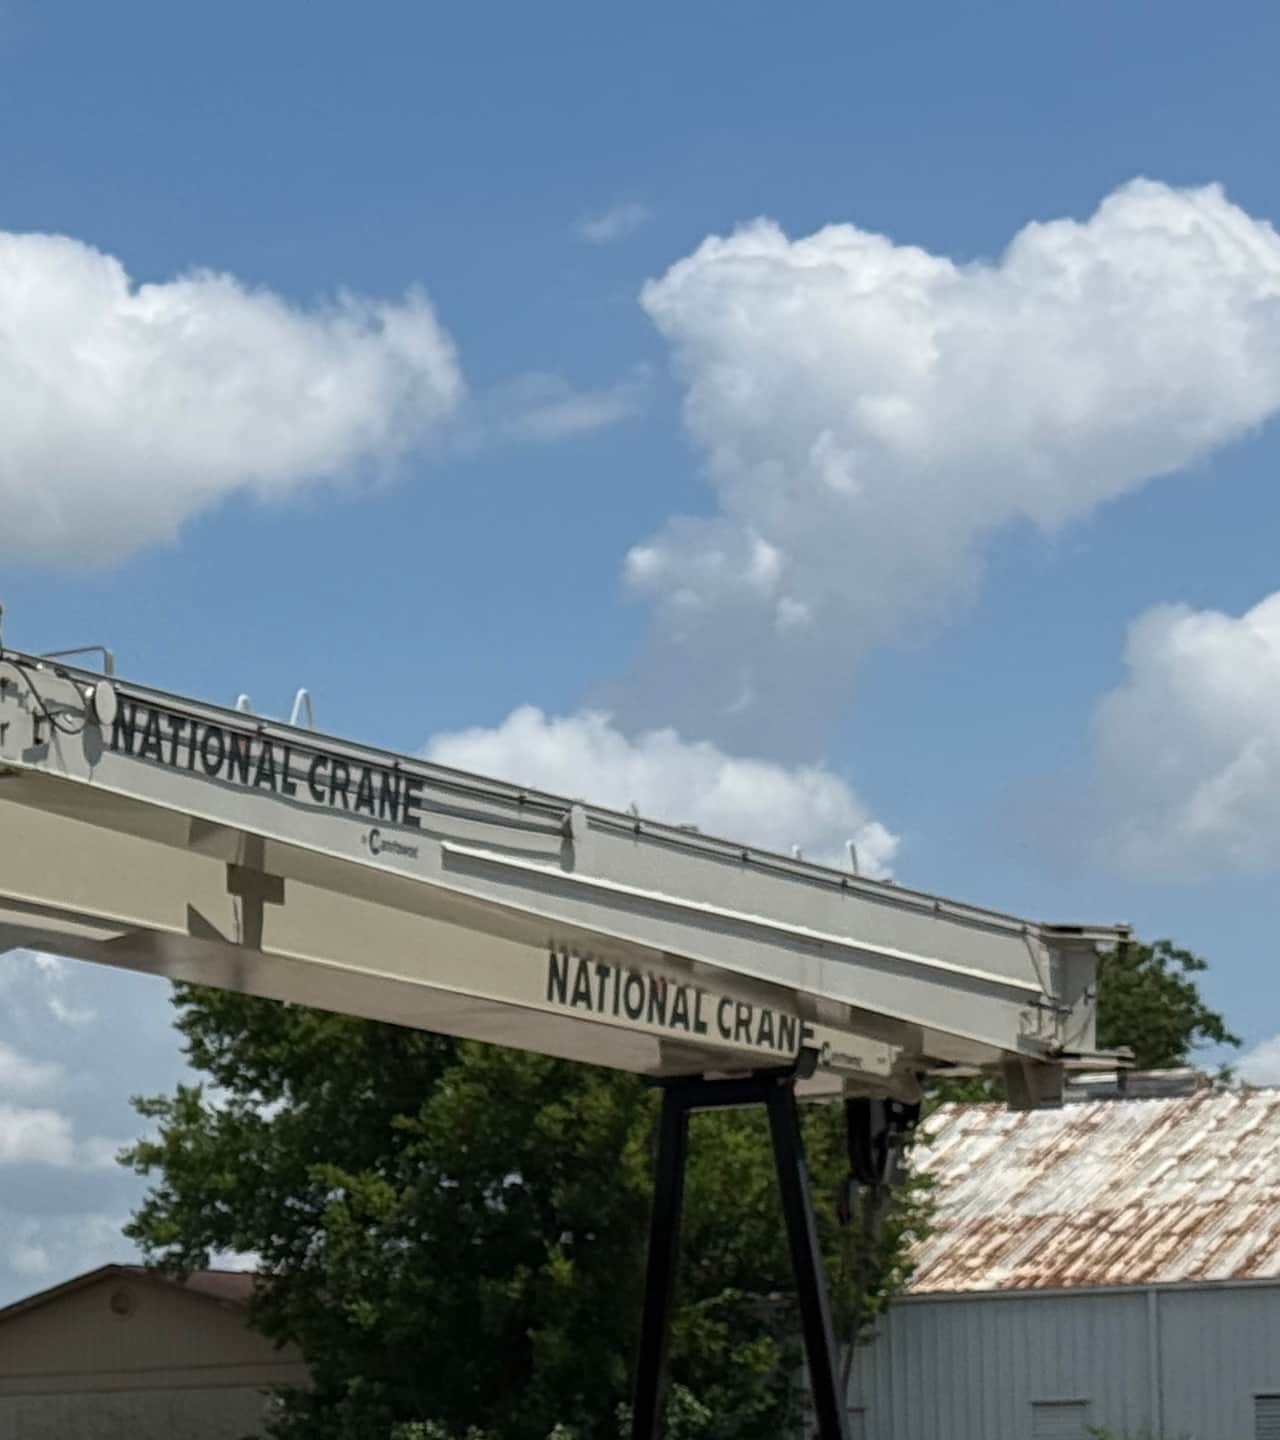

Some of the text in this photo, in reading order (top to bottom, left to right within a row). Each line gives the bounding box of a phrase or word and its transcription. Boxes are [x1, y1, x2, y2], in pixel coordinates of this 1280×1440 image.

[110, 701, 424, 829] NATIONAL CRANE
[546, 952, 708, 1035] NATIONAL
